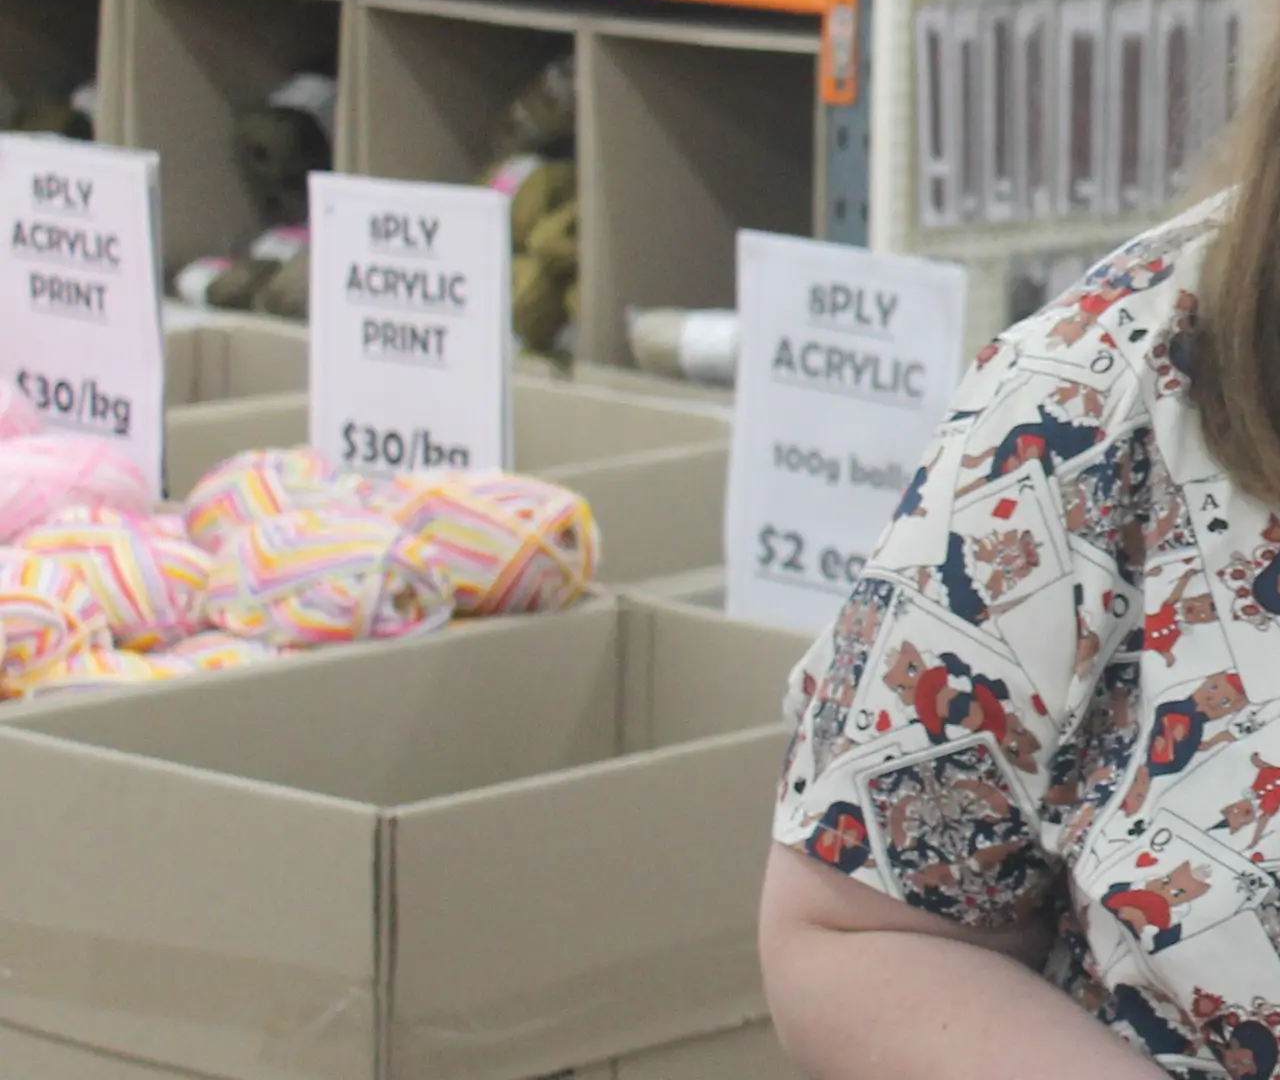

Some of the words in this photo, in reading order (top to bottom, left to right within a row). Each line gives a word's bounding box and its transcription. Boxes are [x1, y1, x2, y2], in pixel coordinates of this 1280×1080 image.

[12, 221, 121, 266] ACRYLIC
[29, 271, 108, 312] PRINT
[347, 264, 467, 306] ACRYLIC
[808, 281, 897, 328] 8PLY
[361, 316, 447, 358] PRINT
[772, 336, 926, 399] ACRYLIC
[756, 524, 806, 574] $2
